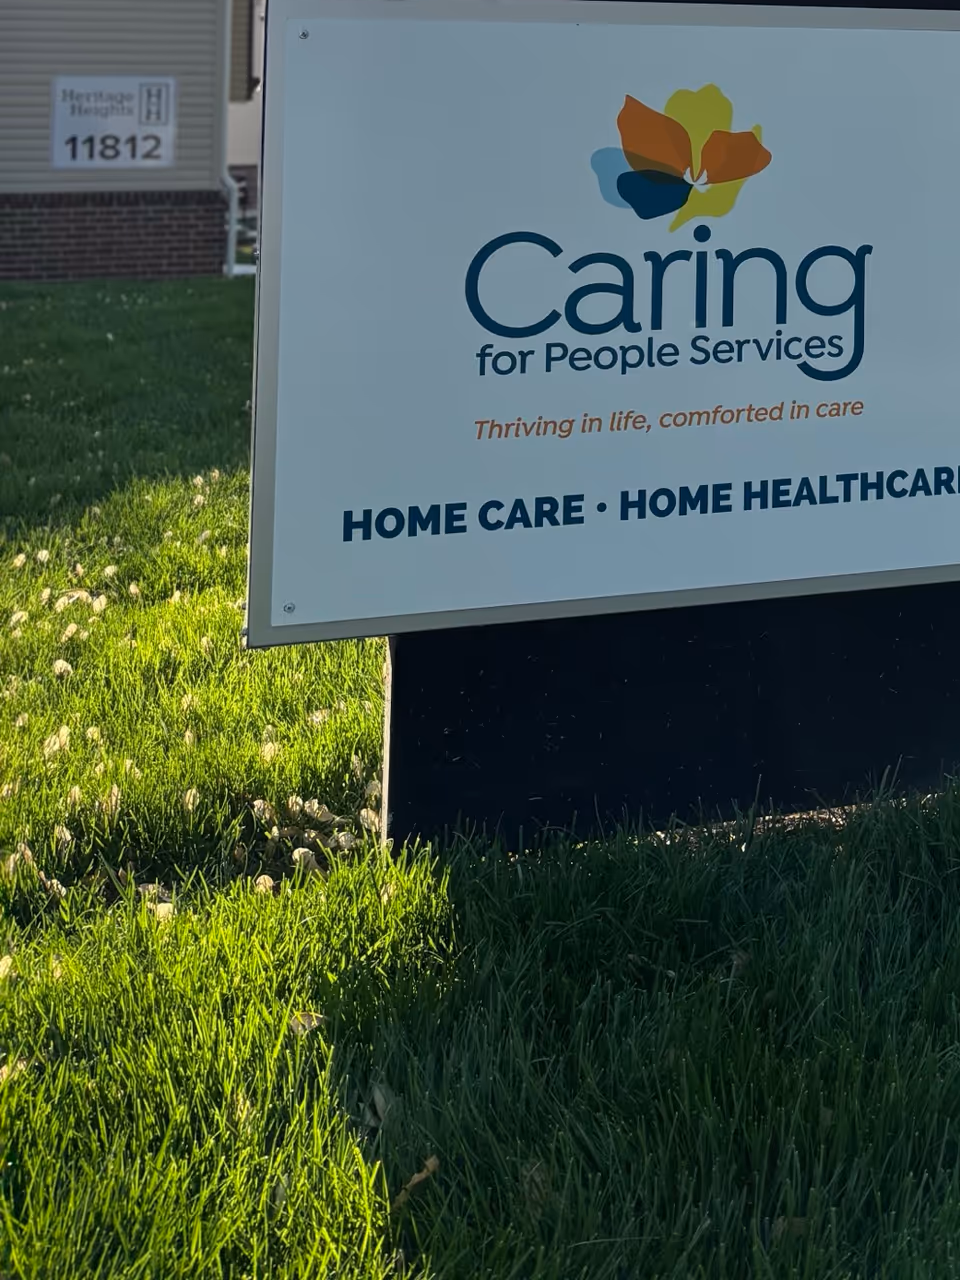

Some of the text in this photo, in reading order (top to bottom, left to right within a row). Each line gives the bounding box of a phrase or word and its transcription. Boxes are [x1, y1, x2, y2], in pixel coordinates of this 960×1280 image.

[61, 89, 135, 105] Heritage
[69, 103, 134, 119] Heights
[65, 134, 162, 161] 11812
[464, 224, 874, 382] Caring
[475, 328, 844, 377] for People Services
[474, 399, 864, 440] Thriving in life, comforted in care
[342, 501, 468, 543] HOME
[477, 493, 585, 532] CARE
[620, 482, 733, 521] HOME
